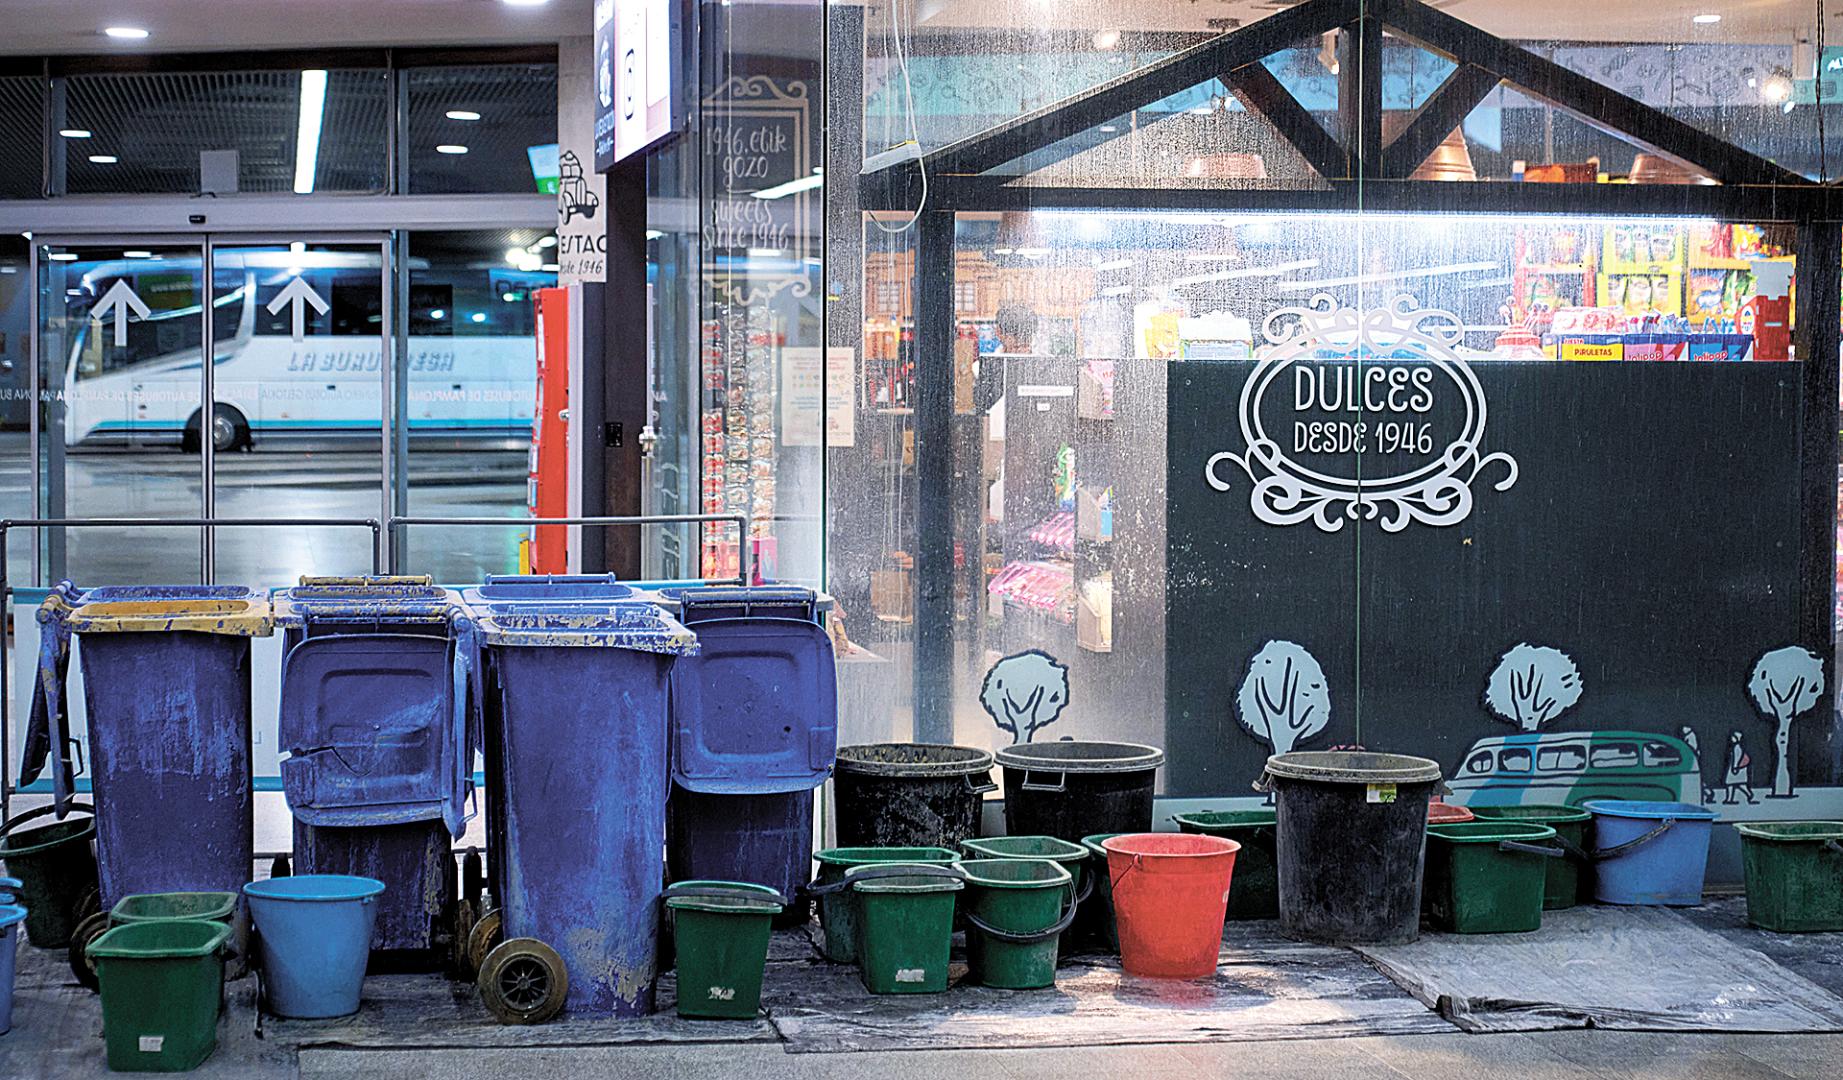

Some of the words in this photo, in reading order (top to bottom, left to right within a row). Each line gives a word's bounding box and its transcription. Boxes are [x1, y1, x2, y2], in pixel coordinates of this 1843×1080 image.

[723, 156, 769, 187] gozo
[711, 199, 773, 224] sweets
[703, 224, 746, 250] since
[752, 223, 789, 250] 1946
[578, 258, 603, 275] 1946
[287, 352, 316, 371] LA
[320, 352, 454, 371] BURUESA
[1574, 348, 1613, 356] PIRULETAS
[1294, 365, 1434, 412] DULCES
[1293, 421, 1368, 453] DESDE
[1374, 421, 1433, 453] 1946
